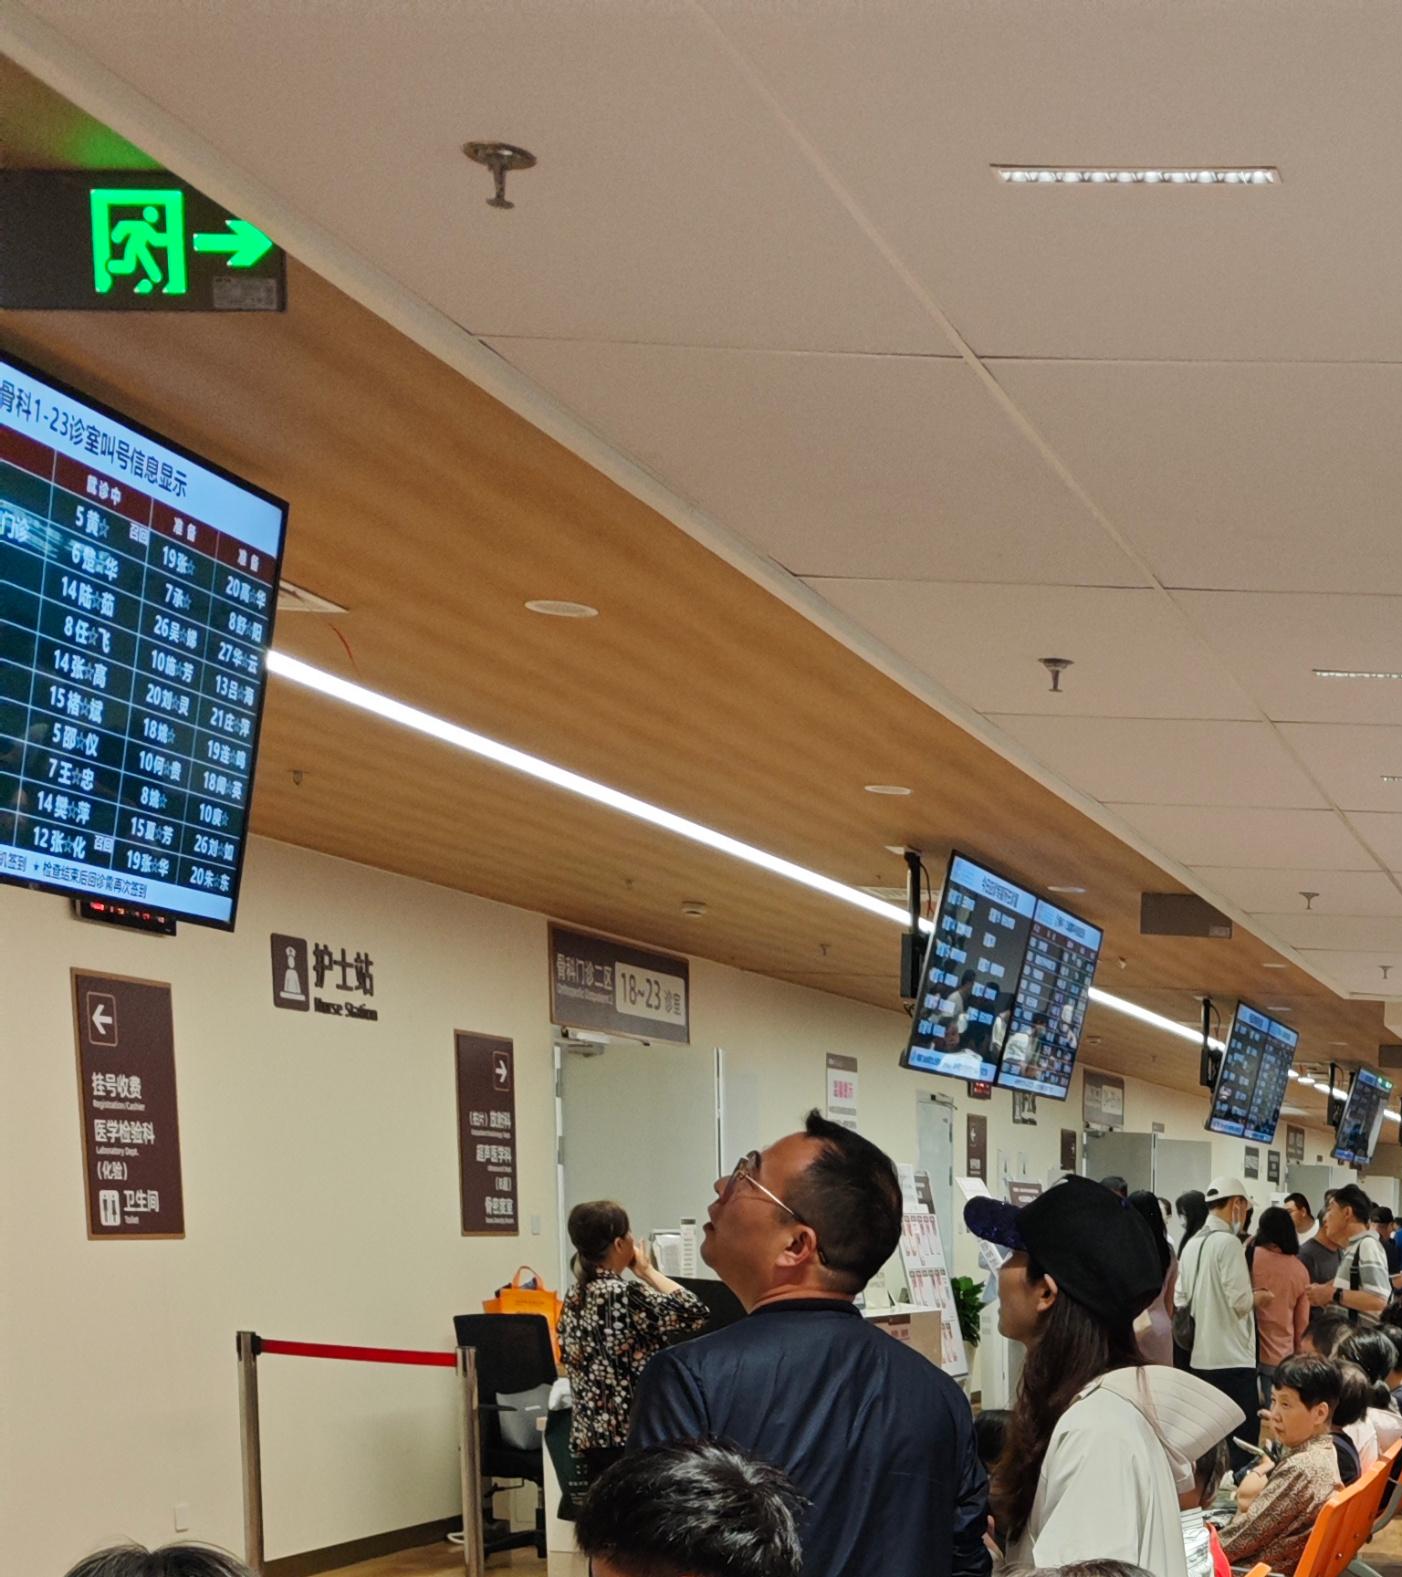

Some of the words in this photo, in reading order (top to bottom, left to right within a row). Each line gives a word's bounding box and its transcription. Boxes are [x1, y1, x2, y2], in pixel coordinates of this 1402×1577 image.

[0, 379, 188, 498] 骨科1-23诊室叫号信息显示
[0, 510, 30, 543] 门诊
[312, 942, 374, 997] 护士站
[556, 953, 613, 991] 骨科门诊二区
[620, 972, 661, 1011] 18~23
[313, 997, 343, 1016] Nurse
[344, 1001, 378, 1022] Station
[91, 1071, 142, 1100] 挂号收费
[94, 1119, 156, 1145] 医学检验科
[123, 1189, 160, 1213] 卫生间
